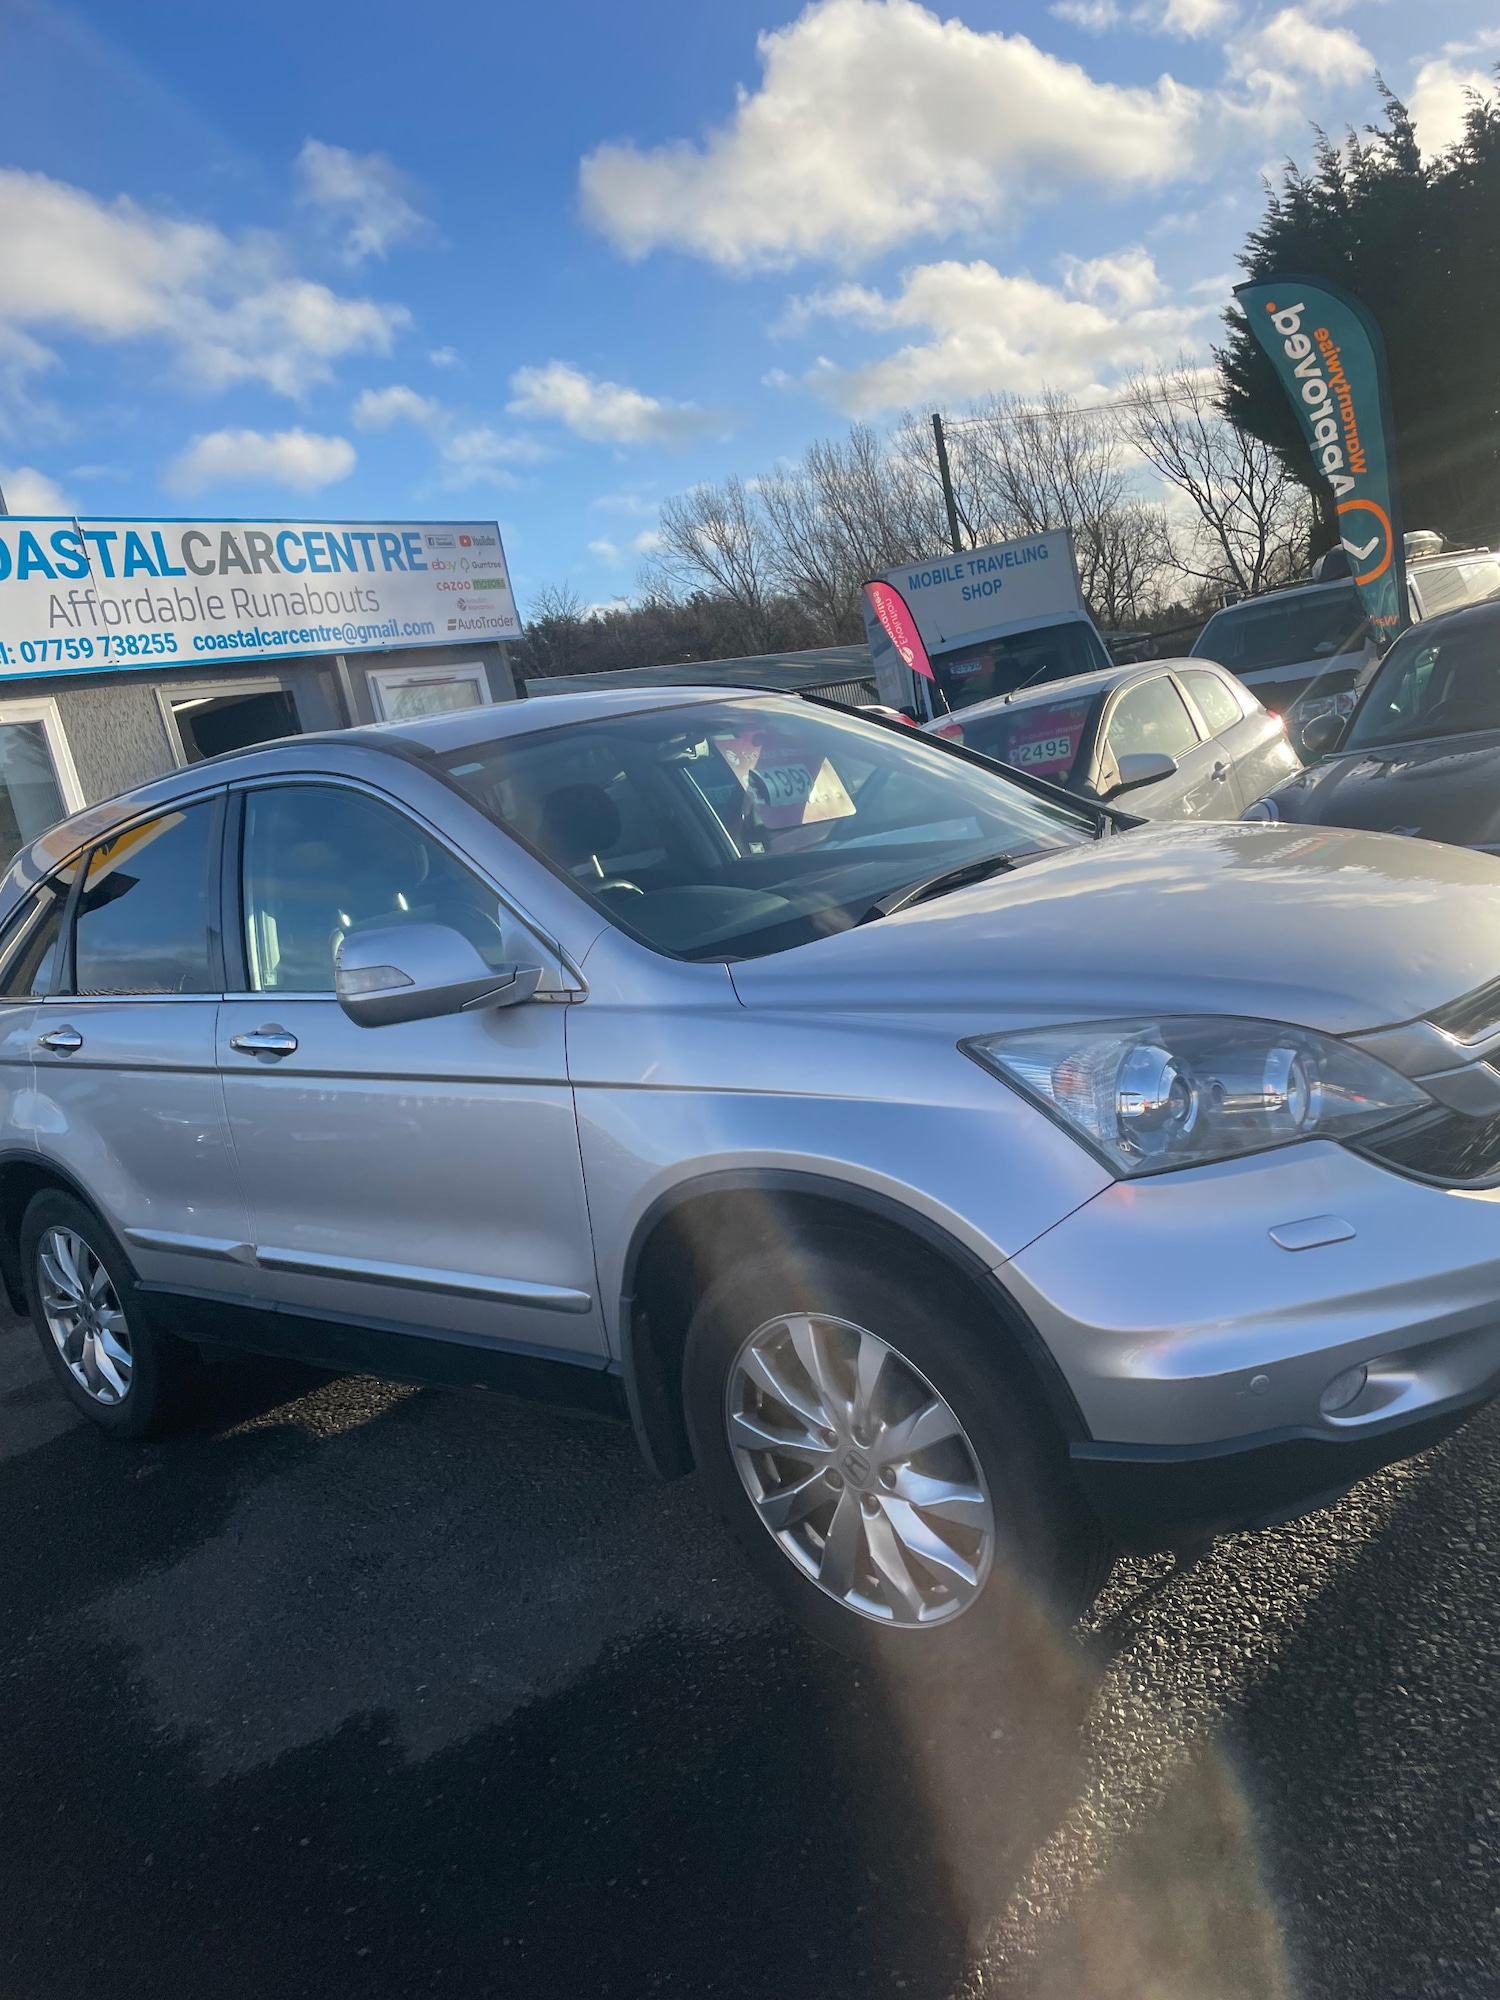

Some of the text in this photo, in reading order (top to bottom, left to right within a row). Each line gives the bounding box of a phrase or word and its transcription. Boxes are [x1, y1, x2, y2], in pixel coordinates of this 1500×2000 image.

[472, 535, 496, 546] YouTube
[472, 561, 502, 569] Gumtree
[908, 544, 1049, 591] MOBILE TRAVELING
[961, 579, 1003, 601] SHOP
[49, 583, 380, 629] Affordable Runabouts
[458, 616, 513, 630] AutoTrader
[20, 637, 93, 663] 07759
[96, 632, 178, 657] 738255
[193, 619, 436, 651] coastalcarcentre@gmail.com
